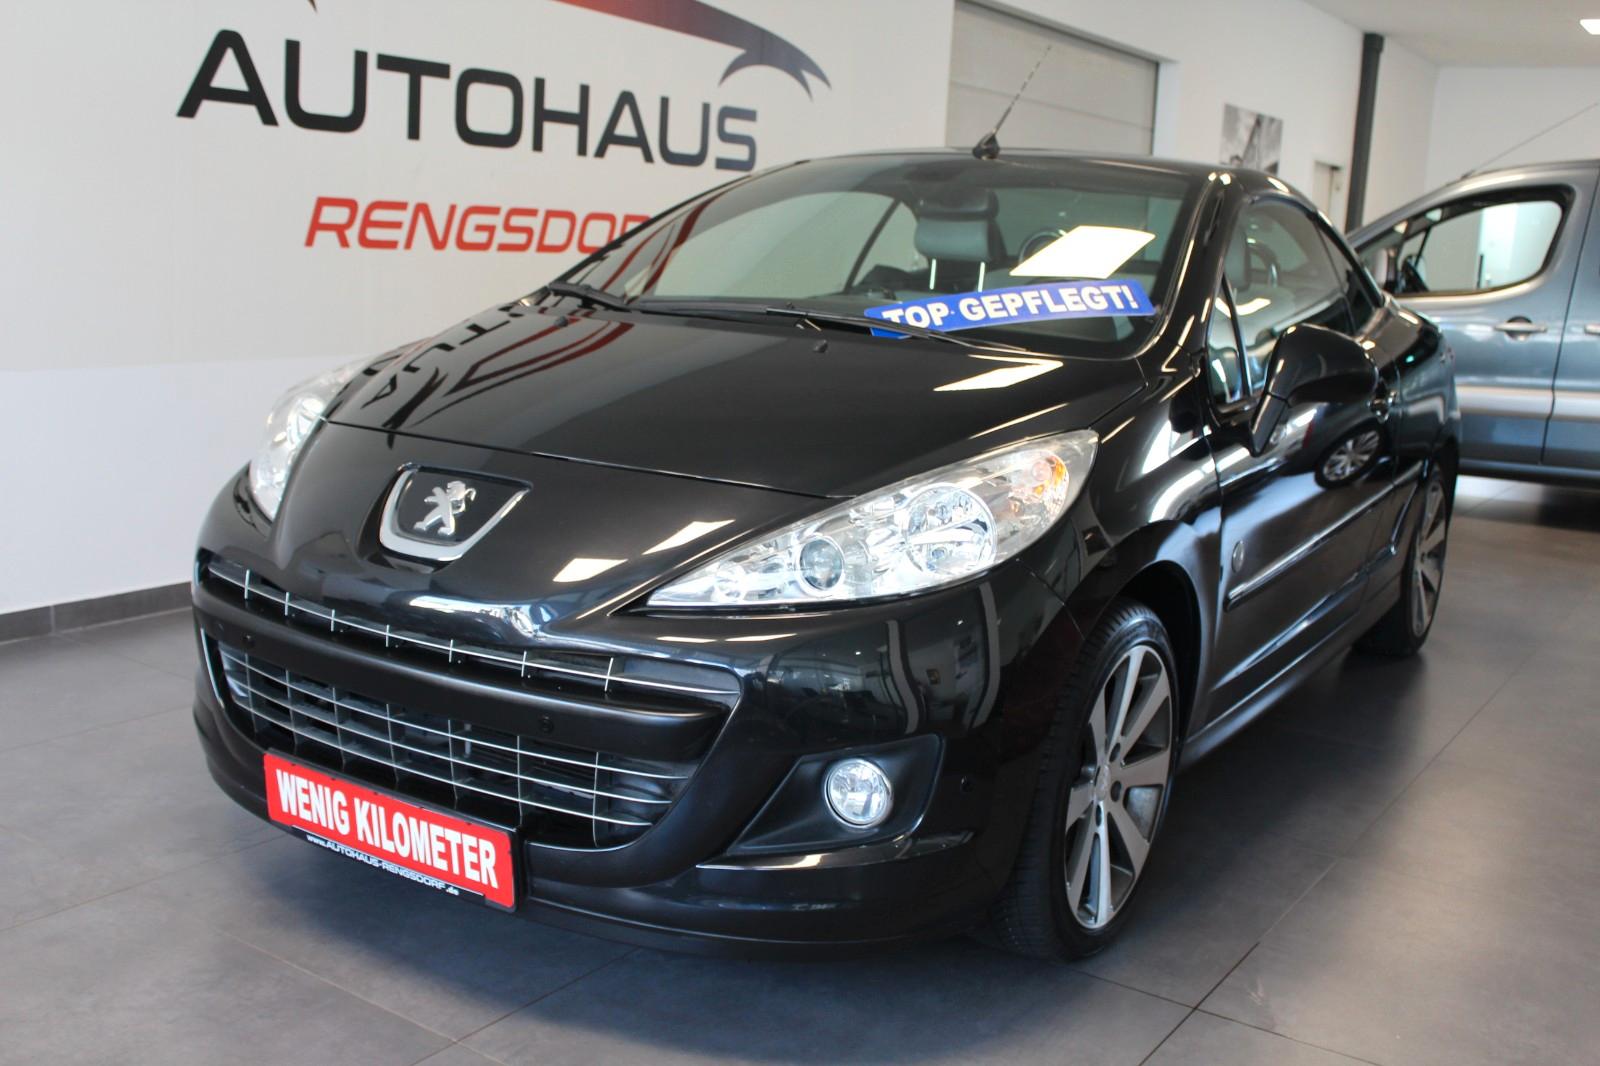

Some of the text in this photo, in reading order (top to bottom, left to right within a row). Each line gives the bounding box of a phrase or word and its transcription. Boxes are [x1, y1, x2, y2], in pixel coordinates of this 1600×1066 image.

[176, 29, 757, 172] AUTOHAUS
[881, 284, 1139, 330] TOP GEPFLEGT!
[275, 768, 499, 889] WENIG KILOMETER
